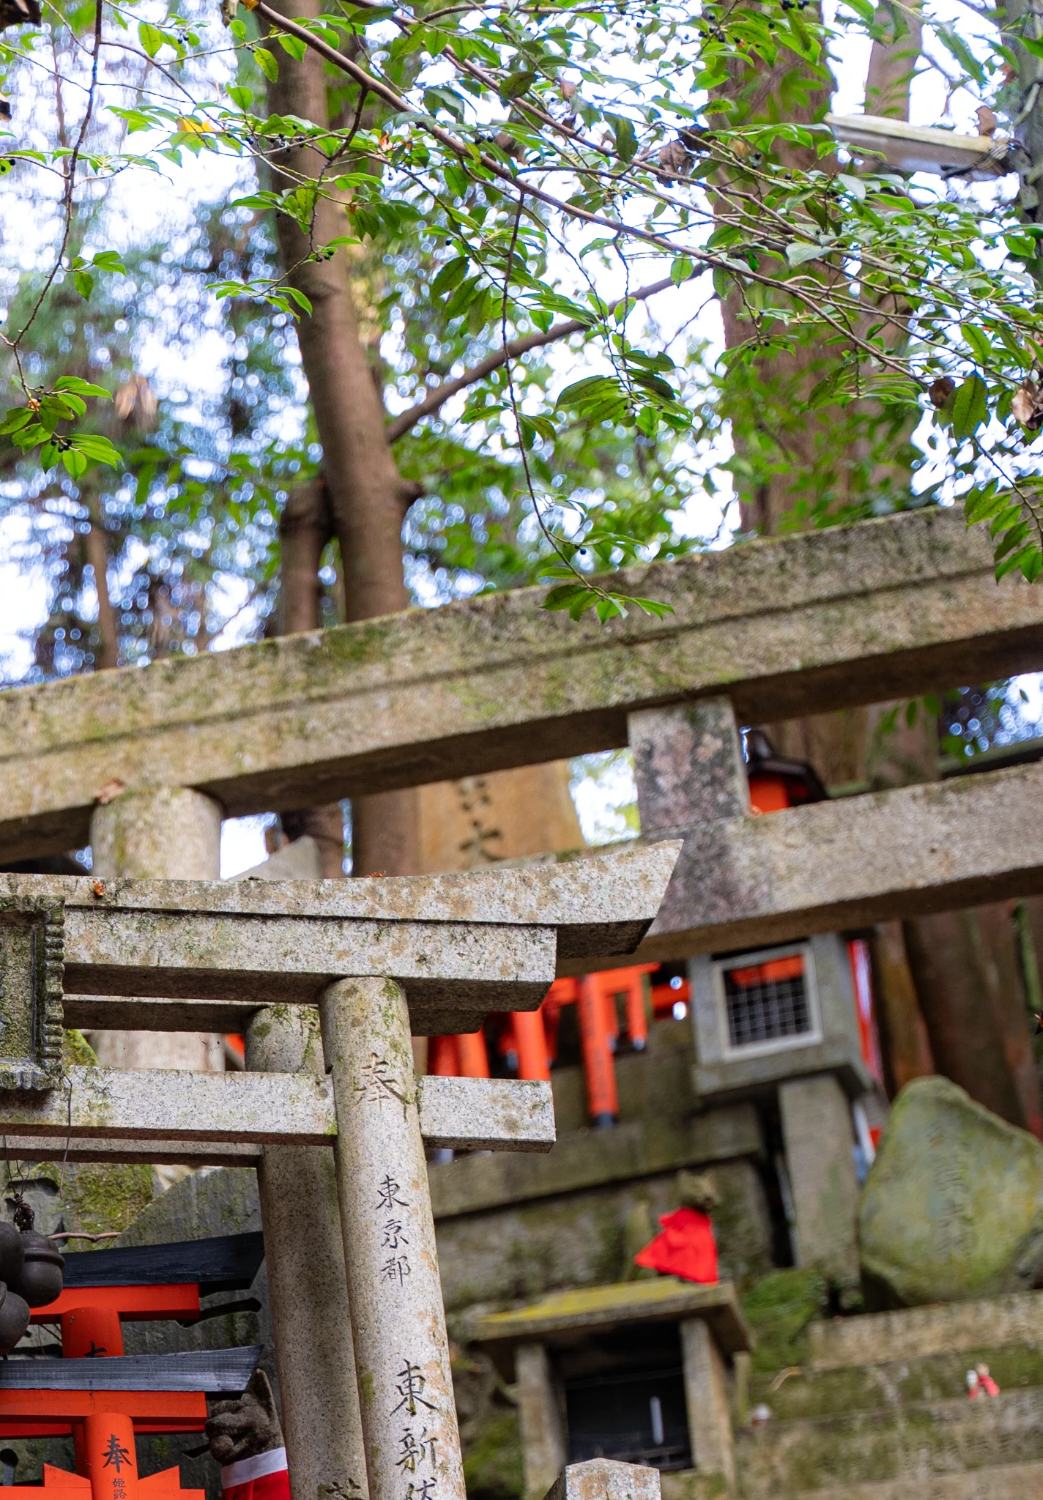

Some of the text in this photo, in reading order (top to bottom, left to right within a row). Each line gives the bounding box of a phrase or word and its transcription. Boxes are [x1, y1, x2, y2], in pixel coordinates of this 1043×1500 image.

[377, 1174, 411, 1288] 東京都
[102, 1434, 133, 1474] 奉
